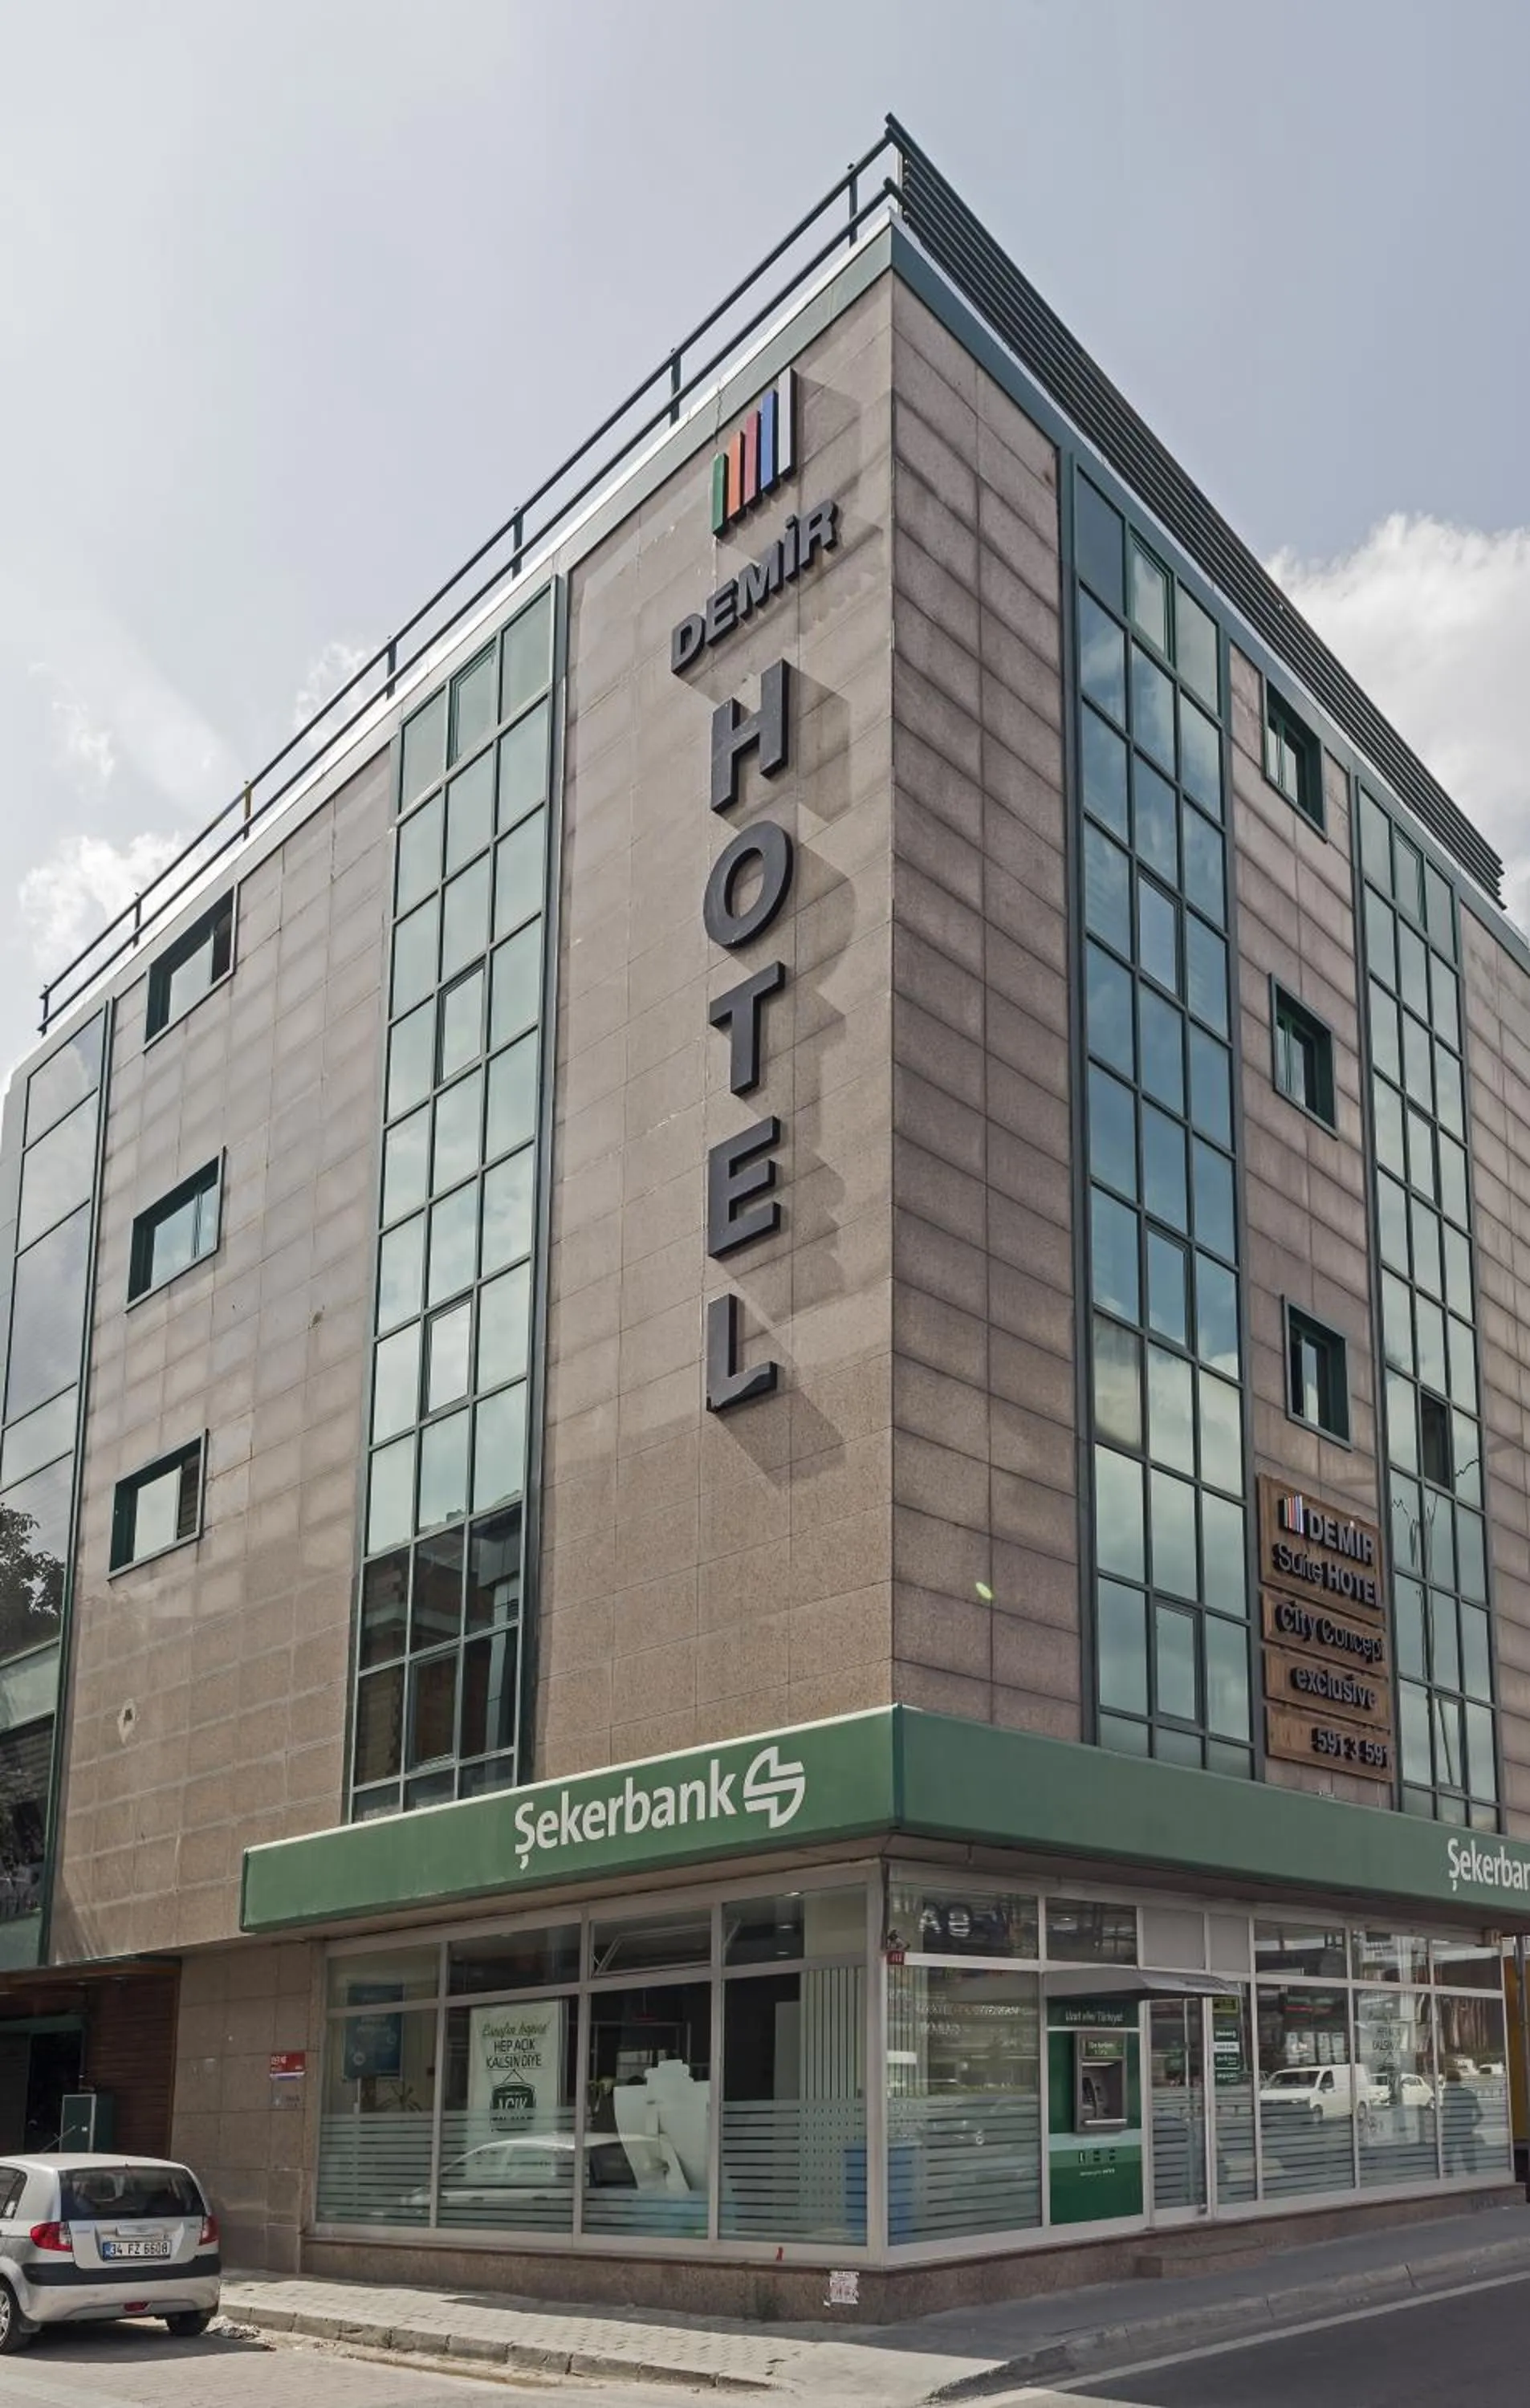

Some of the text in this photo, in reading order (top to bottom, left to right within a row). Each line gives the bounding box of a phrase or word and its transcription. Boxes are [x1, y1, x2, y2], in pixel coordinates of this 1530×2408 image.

[703, 658, 793, 1413] HOTEL
[1275, 1541, 1324, 1585] Suite
[1278, 1601, 1316, 1642] City
[1292, 1668, 1377, 1710] exclusive
[515, 1759, 737, 1870] Şekerbank
[486, 2055, 520, 2069] KALSIN
[494, 2040, 512, 2054] HEP
